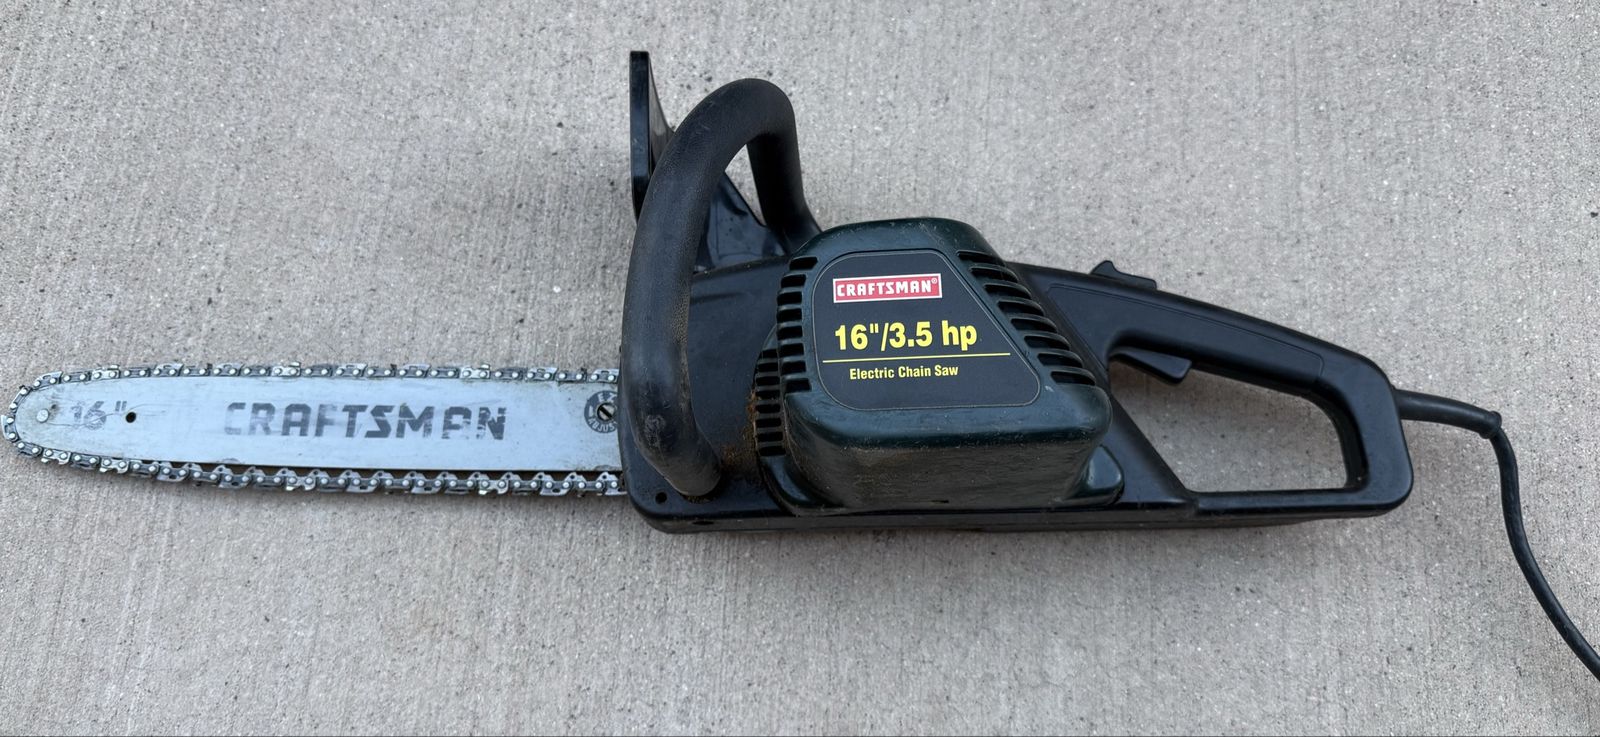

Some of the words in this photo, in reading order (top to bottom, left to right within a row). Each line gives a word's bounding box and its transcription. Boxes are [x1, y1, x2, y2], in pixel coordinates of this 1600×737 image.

[835, 321, 933, 351] 16"/3.5
[941, 320, 977, 351] hp
[849, 365, 895, 380] Electric
[898, 364, 931, 378] Chain
[935, 364, 959, 377] Saw
[223, 402, 507, 440] CRAFTSMAN
